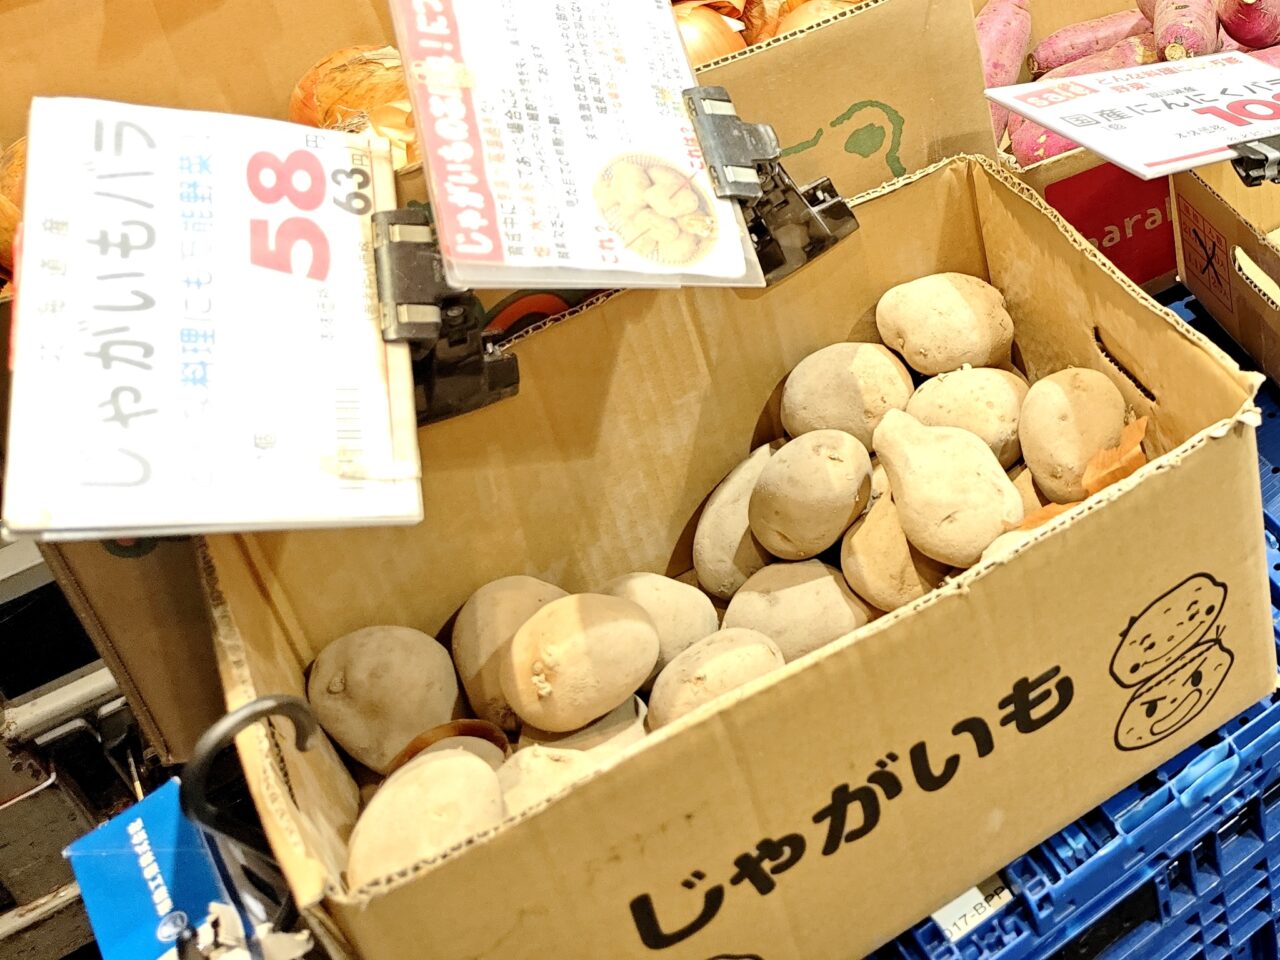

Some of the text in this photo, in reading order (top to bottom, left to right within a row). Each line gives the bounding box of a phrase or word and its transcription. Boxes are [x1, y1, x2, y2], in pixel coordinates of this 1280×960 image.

[77, 119, 158, 489] じゃがいもバラ
[1087, 196, 1173, 248] ara
[629, 664, 1075, 950] じゃがいも
